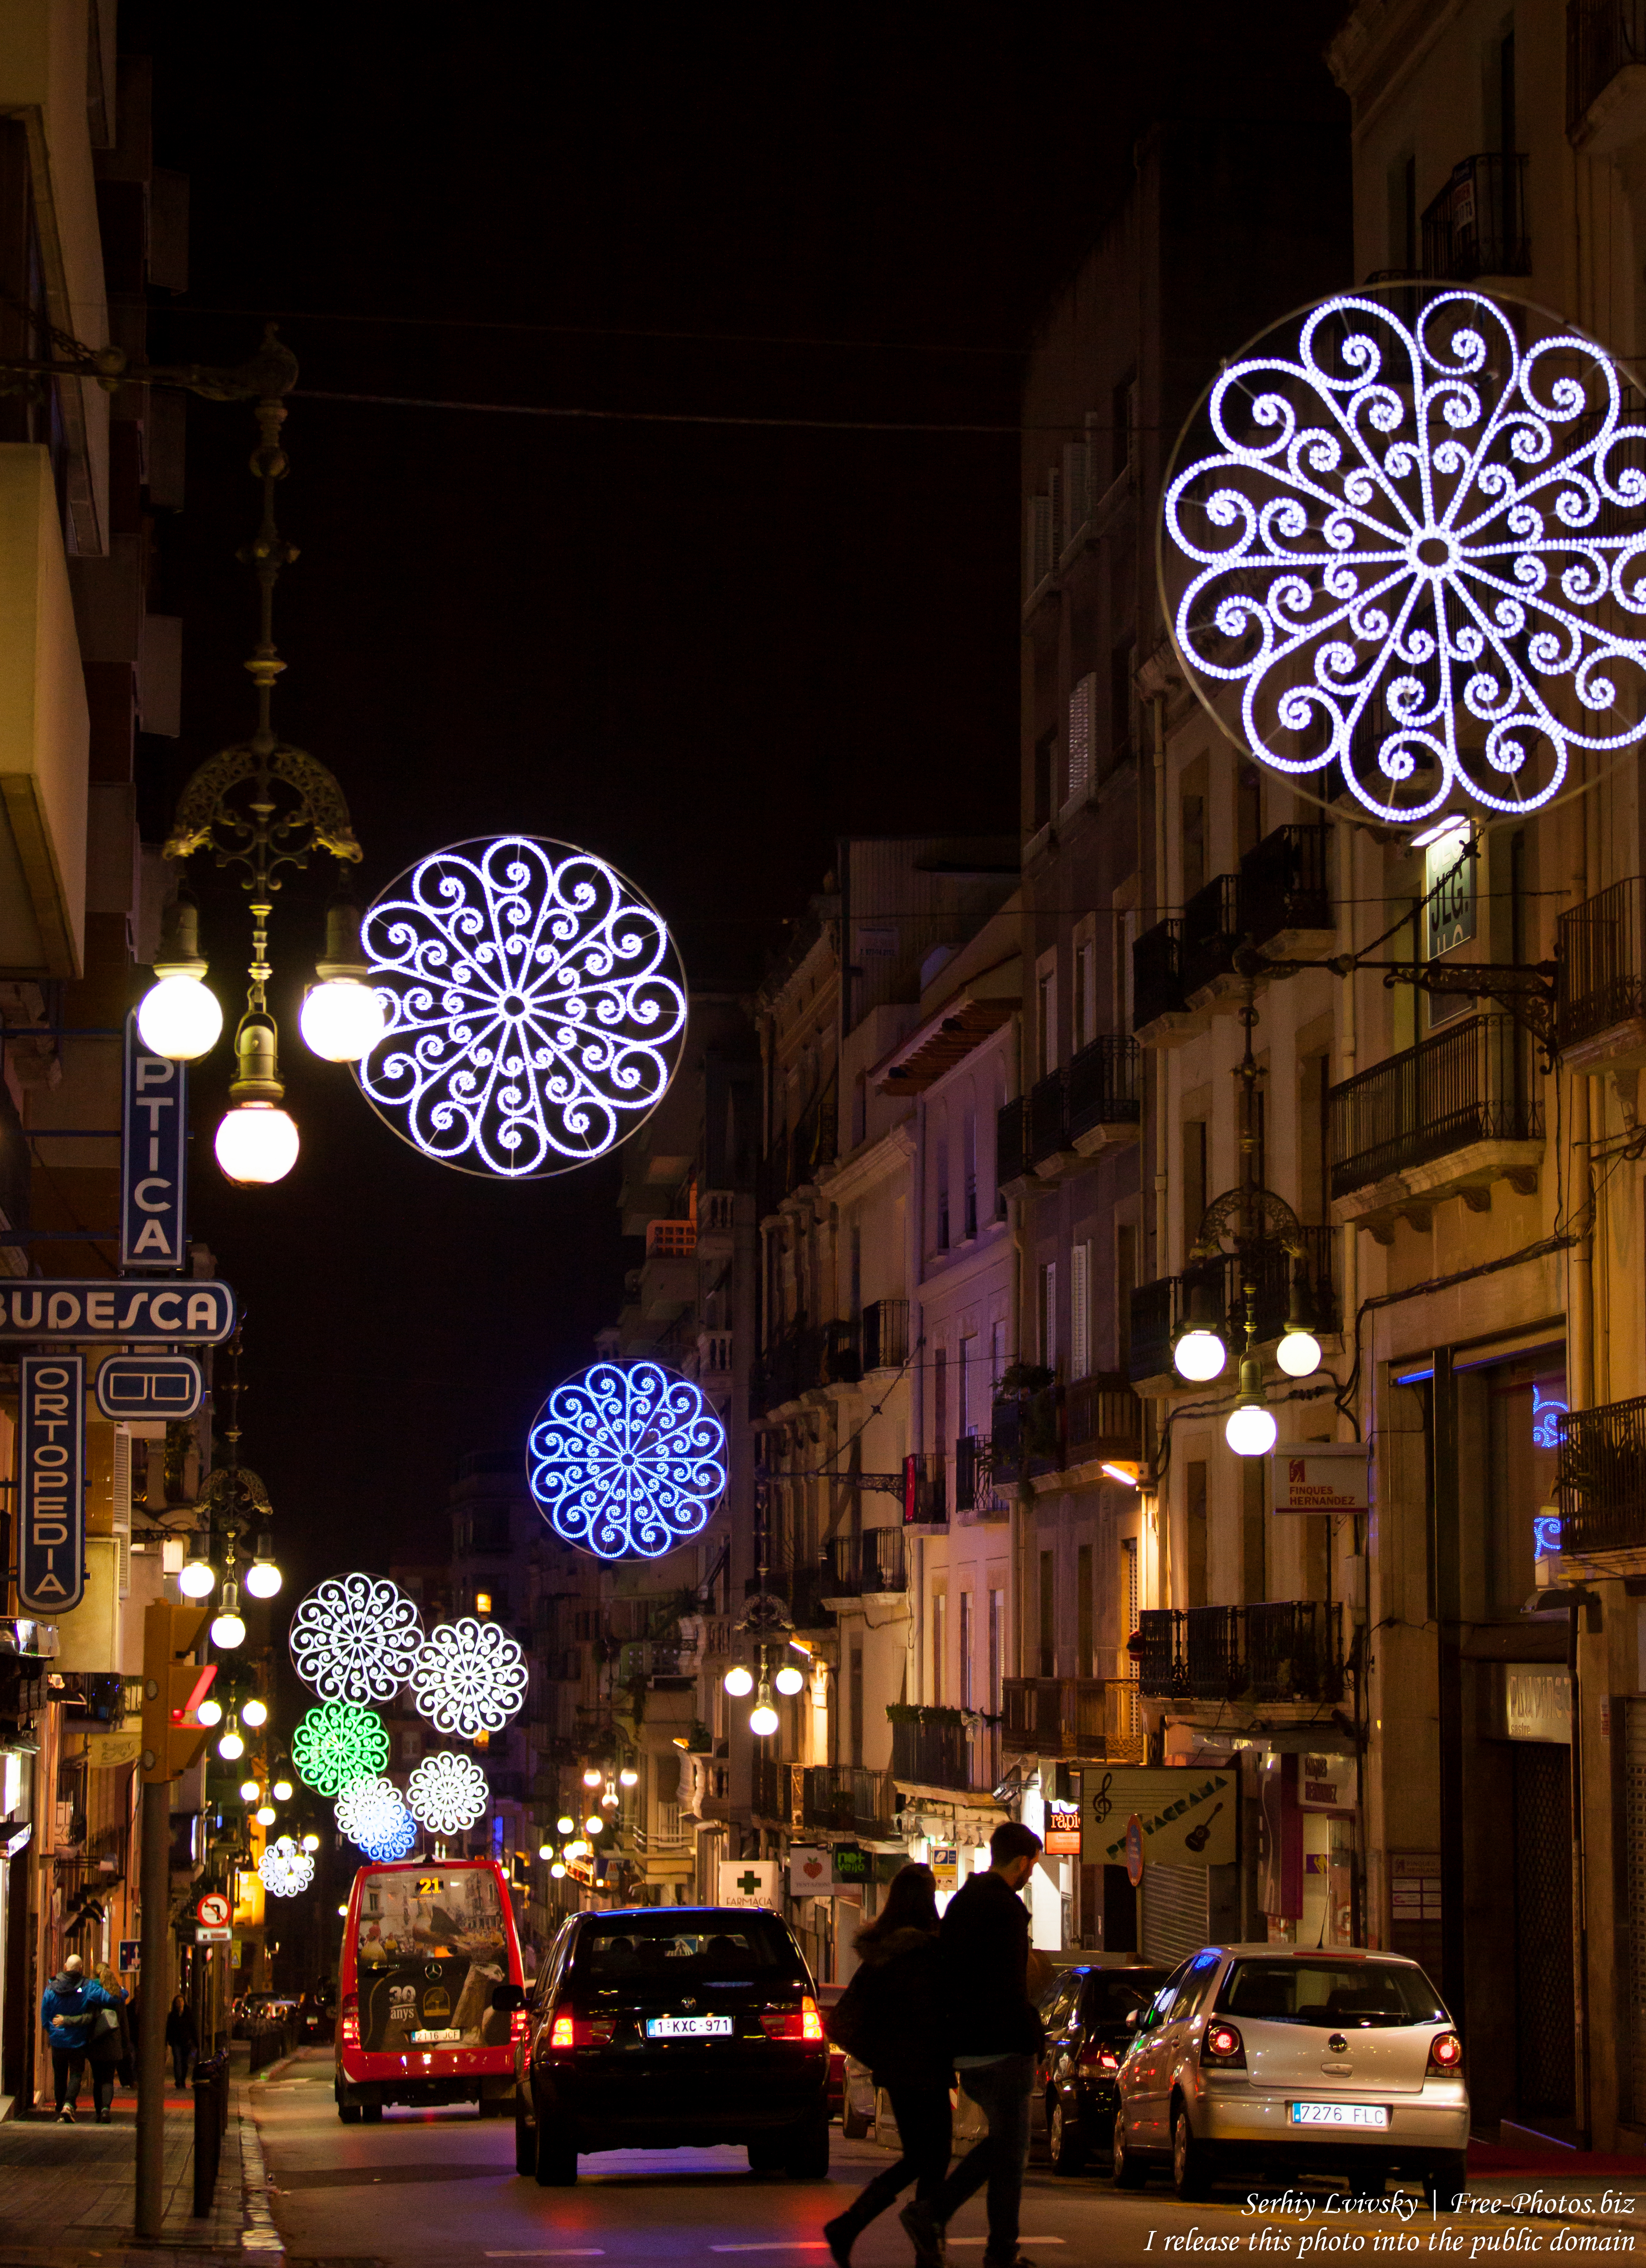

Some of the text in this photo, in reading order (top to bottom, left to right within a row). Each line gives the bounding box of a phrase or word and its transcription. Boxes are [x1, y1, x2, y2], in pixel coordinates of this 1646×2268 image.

[133, 1029, 175, 1254] PTICA
[0, 1291, 218, 1330] UDESCA
[33, 1367, 70, 1596] ORTOPEDIA
[1289, 1486, 1333, 1495] FINQUES
[1289, 1496, 1355, 1506] HERNANDEZ
[1511, 1722, 1531, 1735] sastre
[419, 1877, 442, 1895] 21
[726, 1896, 772, 1906] FARMACIA
[389, 1985, 416, 2003] 30
[390, 2007, 415, 2021] anys
[1301, 2106, 1383, 2124] 7276 FLC
